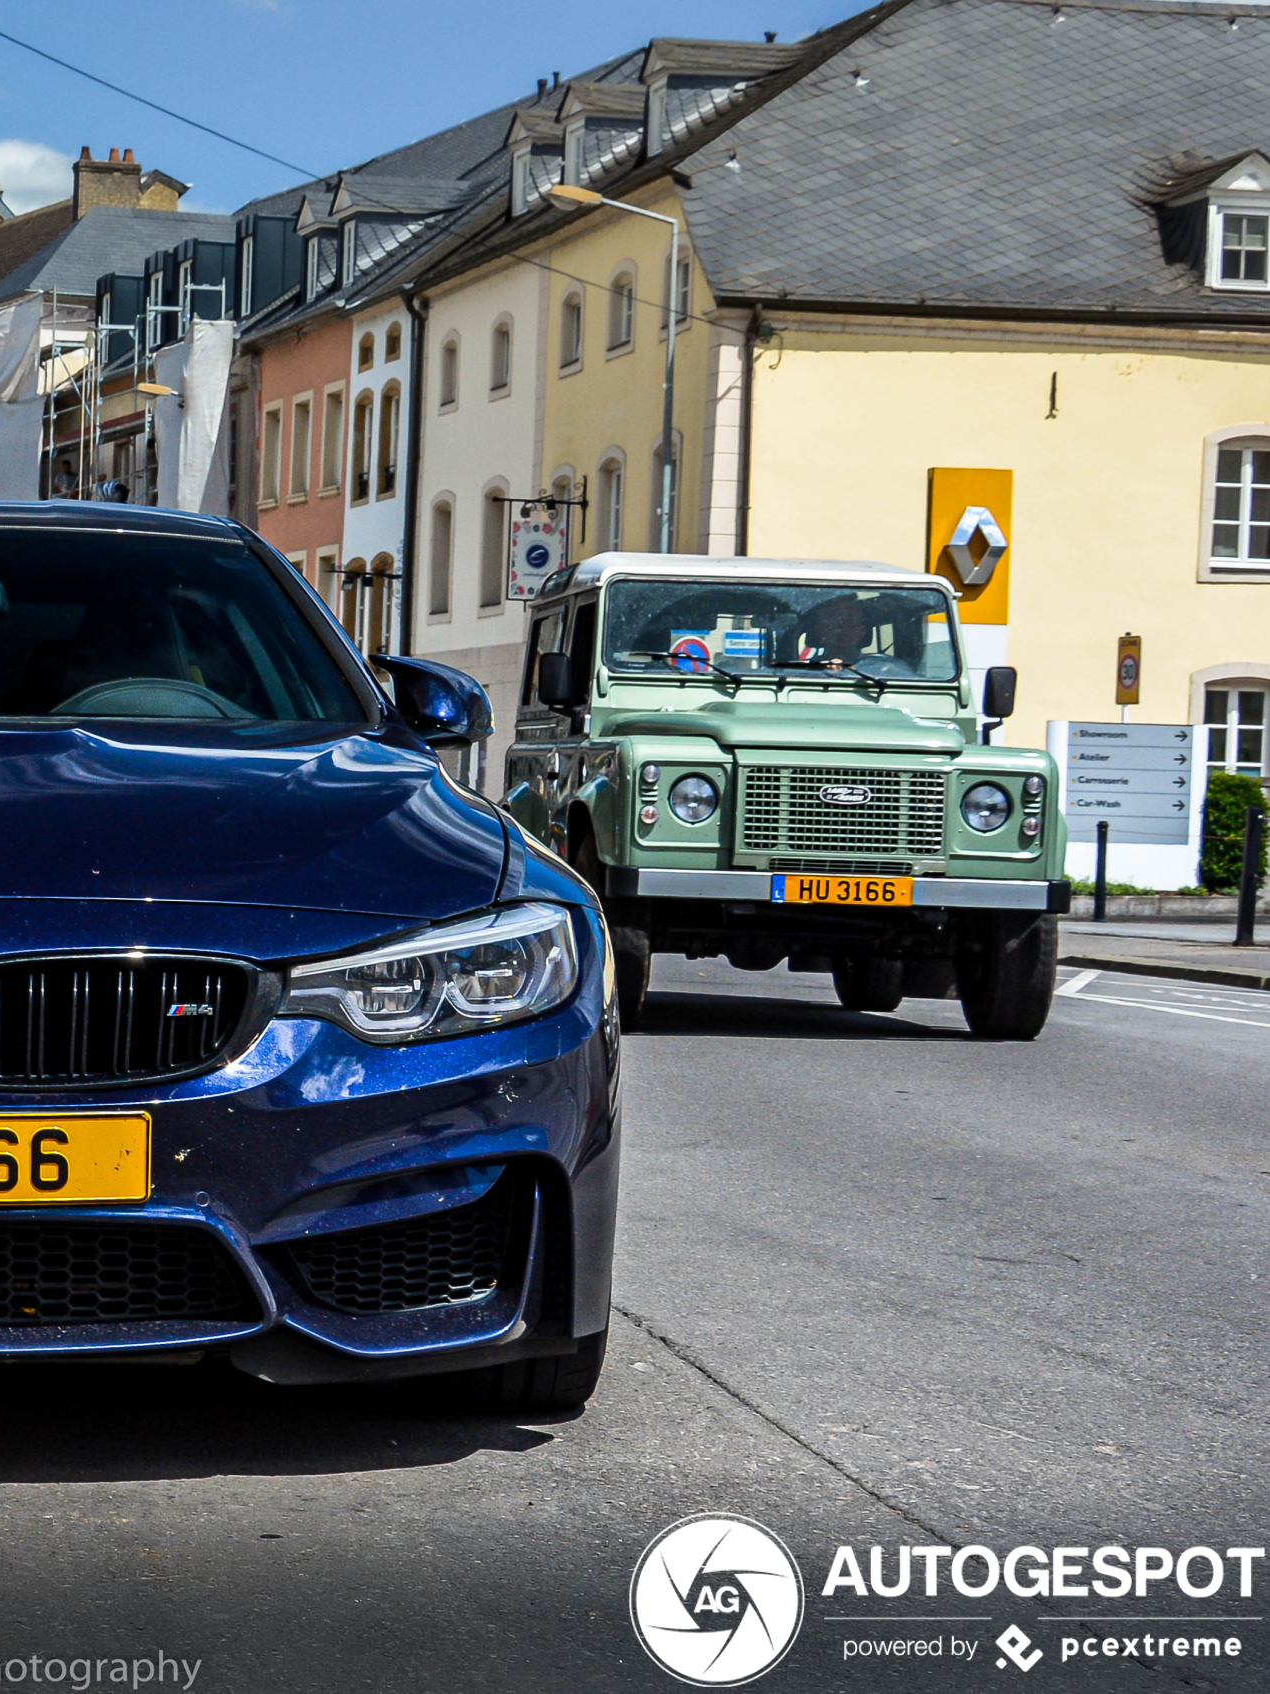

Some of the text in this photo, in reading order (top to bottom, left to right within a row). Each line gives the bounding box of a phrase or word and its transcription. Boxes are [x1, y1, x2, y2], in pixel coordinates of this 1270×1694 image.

[1123, 664, 1133, 680] 30
[1079, 730, 1128, 738] Showroom
[1079, 753, 1110, 761] Atelier
[1077, 776, 1129, 785] Carrosserie
[1077, 799, 1121, 808] Car-Wash
[775, 879, 896, 902] L HU 3166
[178, 1004, 213, 1016] M4
